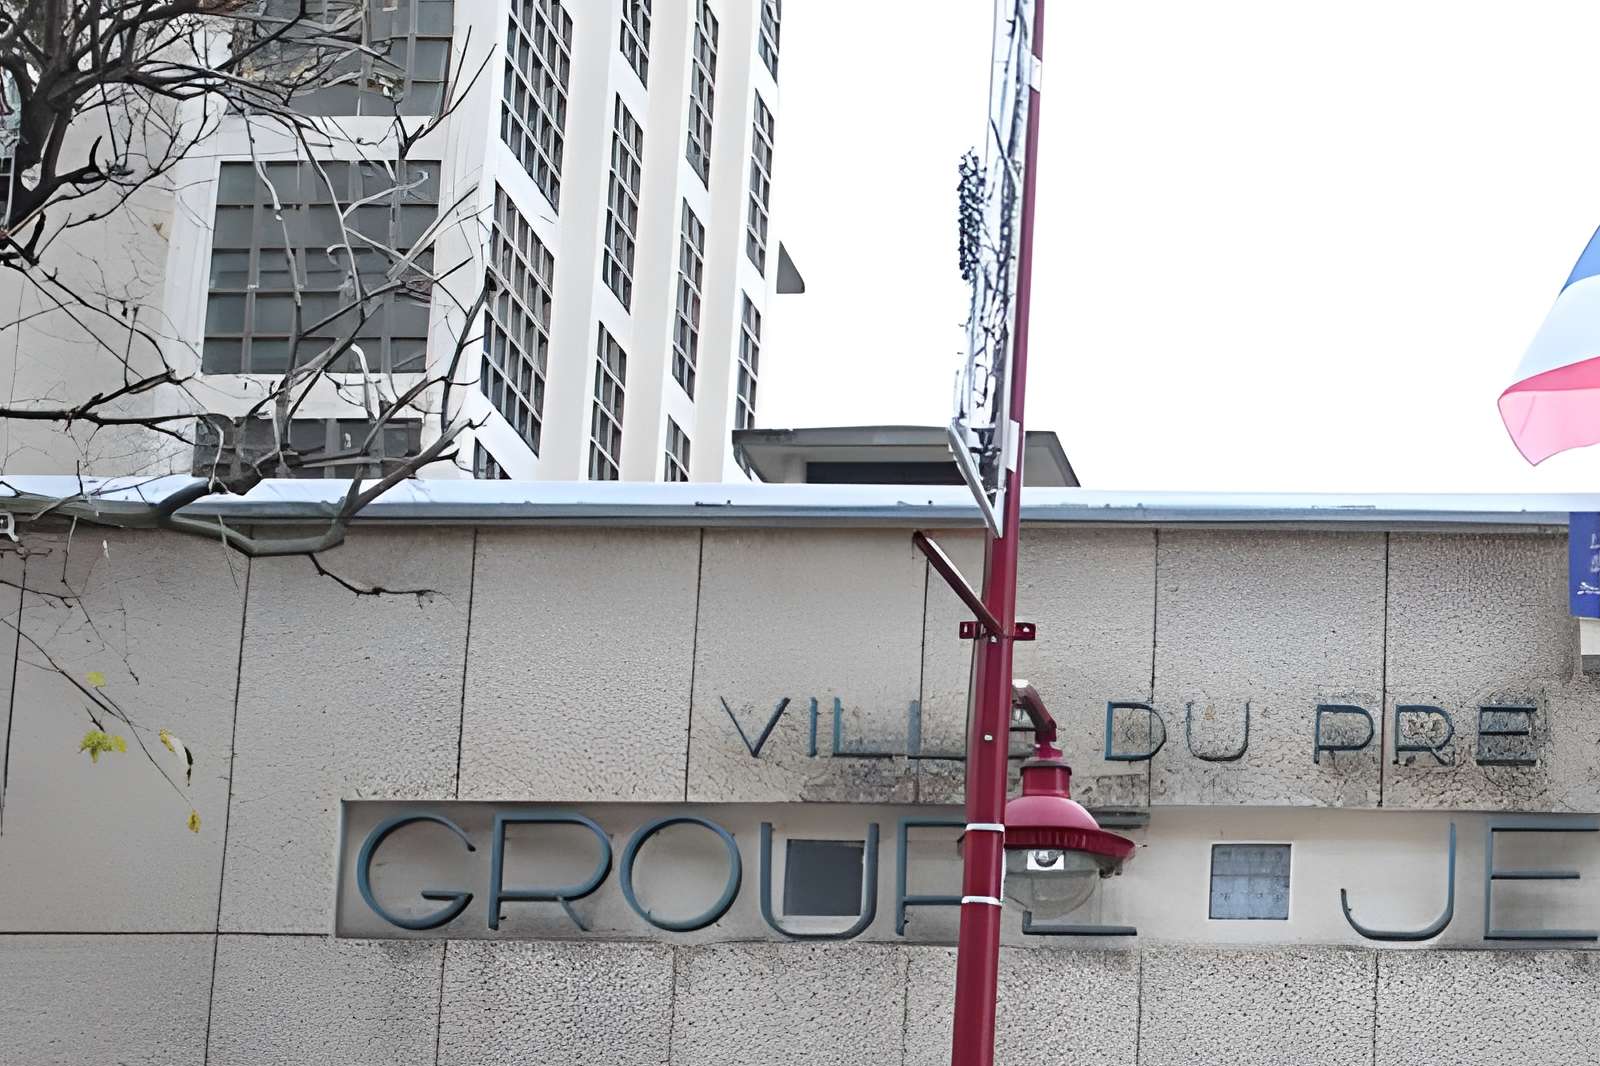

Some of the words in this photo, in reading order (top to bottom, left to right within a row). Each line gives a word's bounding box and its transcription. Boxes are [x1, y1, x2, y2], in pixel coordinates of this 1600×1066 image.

[720, 696, 1036, 764] VILL
[1104, 700, 1250, 762] DU
[1313, 702, 1540, 767] PRE
